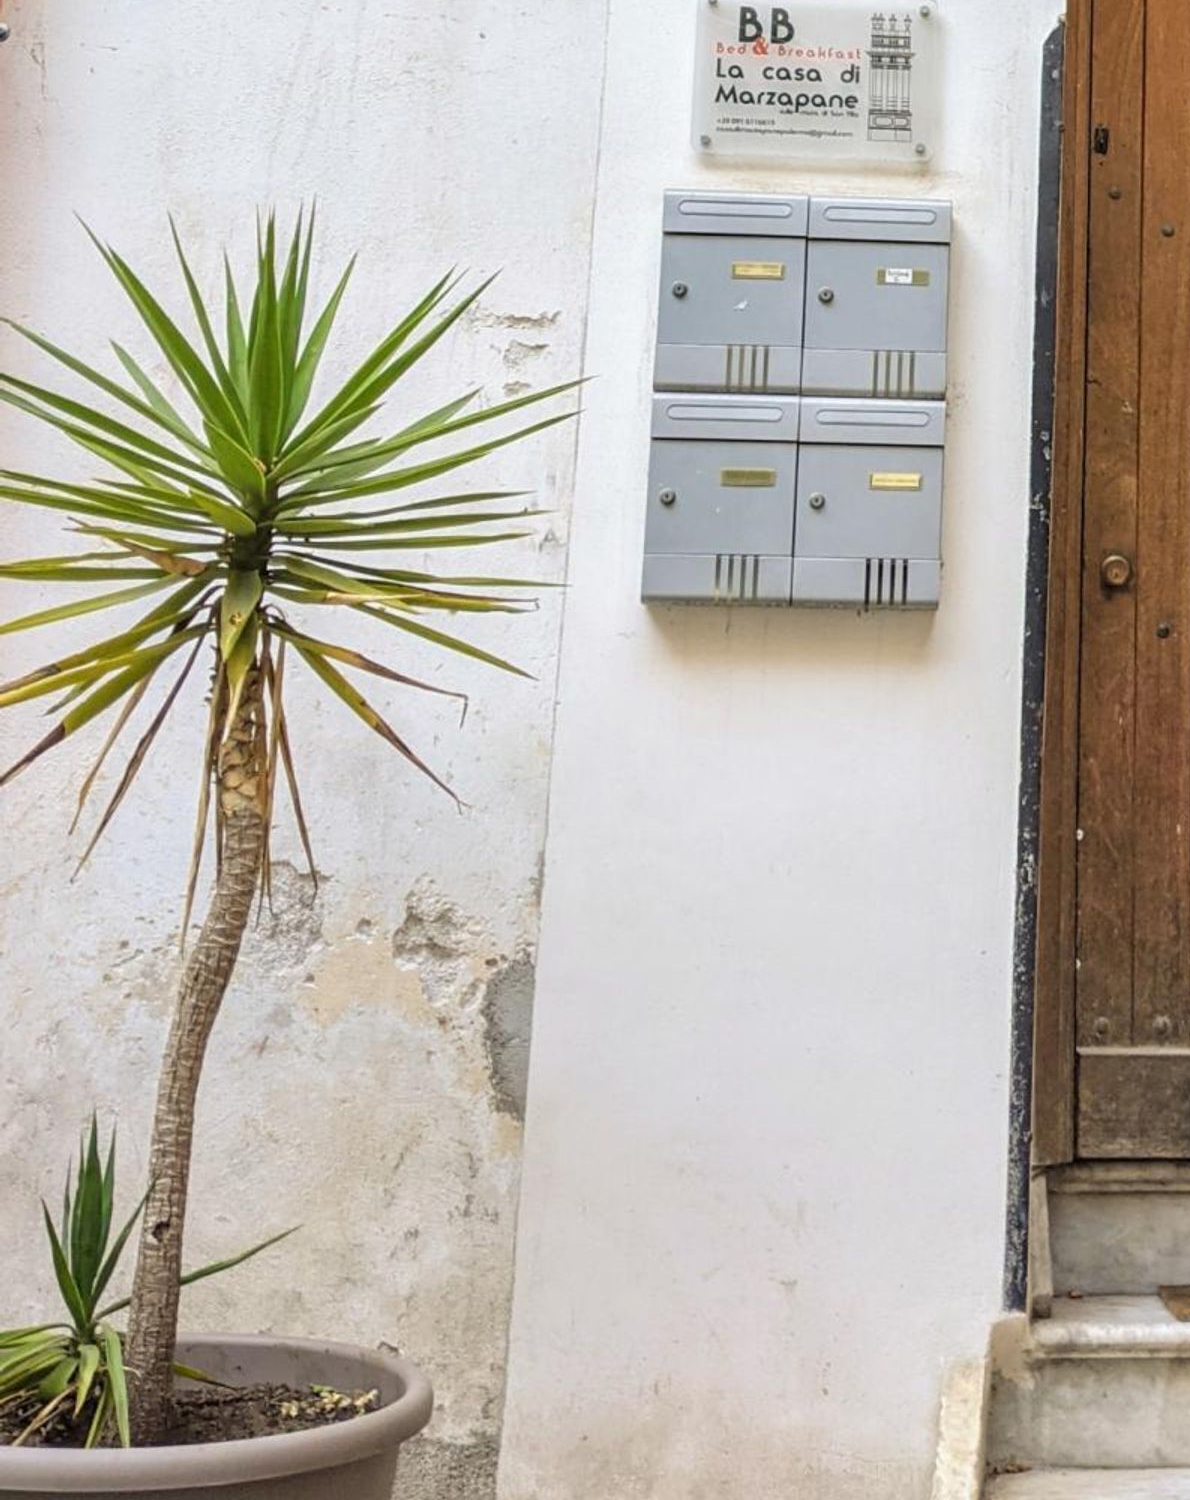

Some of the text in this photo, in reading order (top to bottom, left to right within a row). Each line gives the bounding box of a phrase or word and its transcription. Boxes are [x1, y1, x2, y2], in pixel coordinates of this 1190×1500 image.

[716, 37, 861, 60] Bed & Breakfast
[716, 58, 860, 84] La casa di
[715, 84, 858, 112] Marzapane
